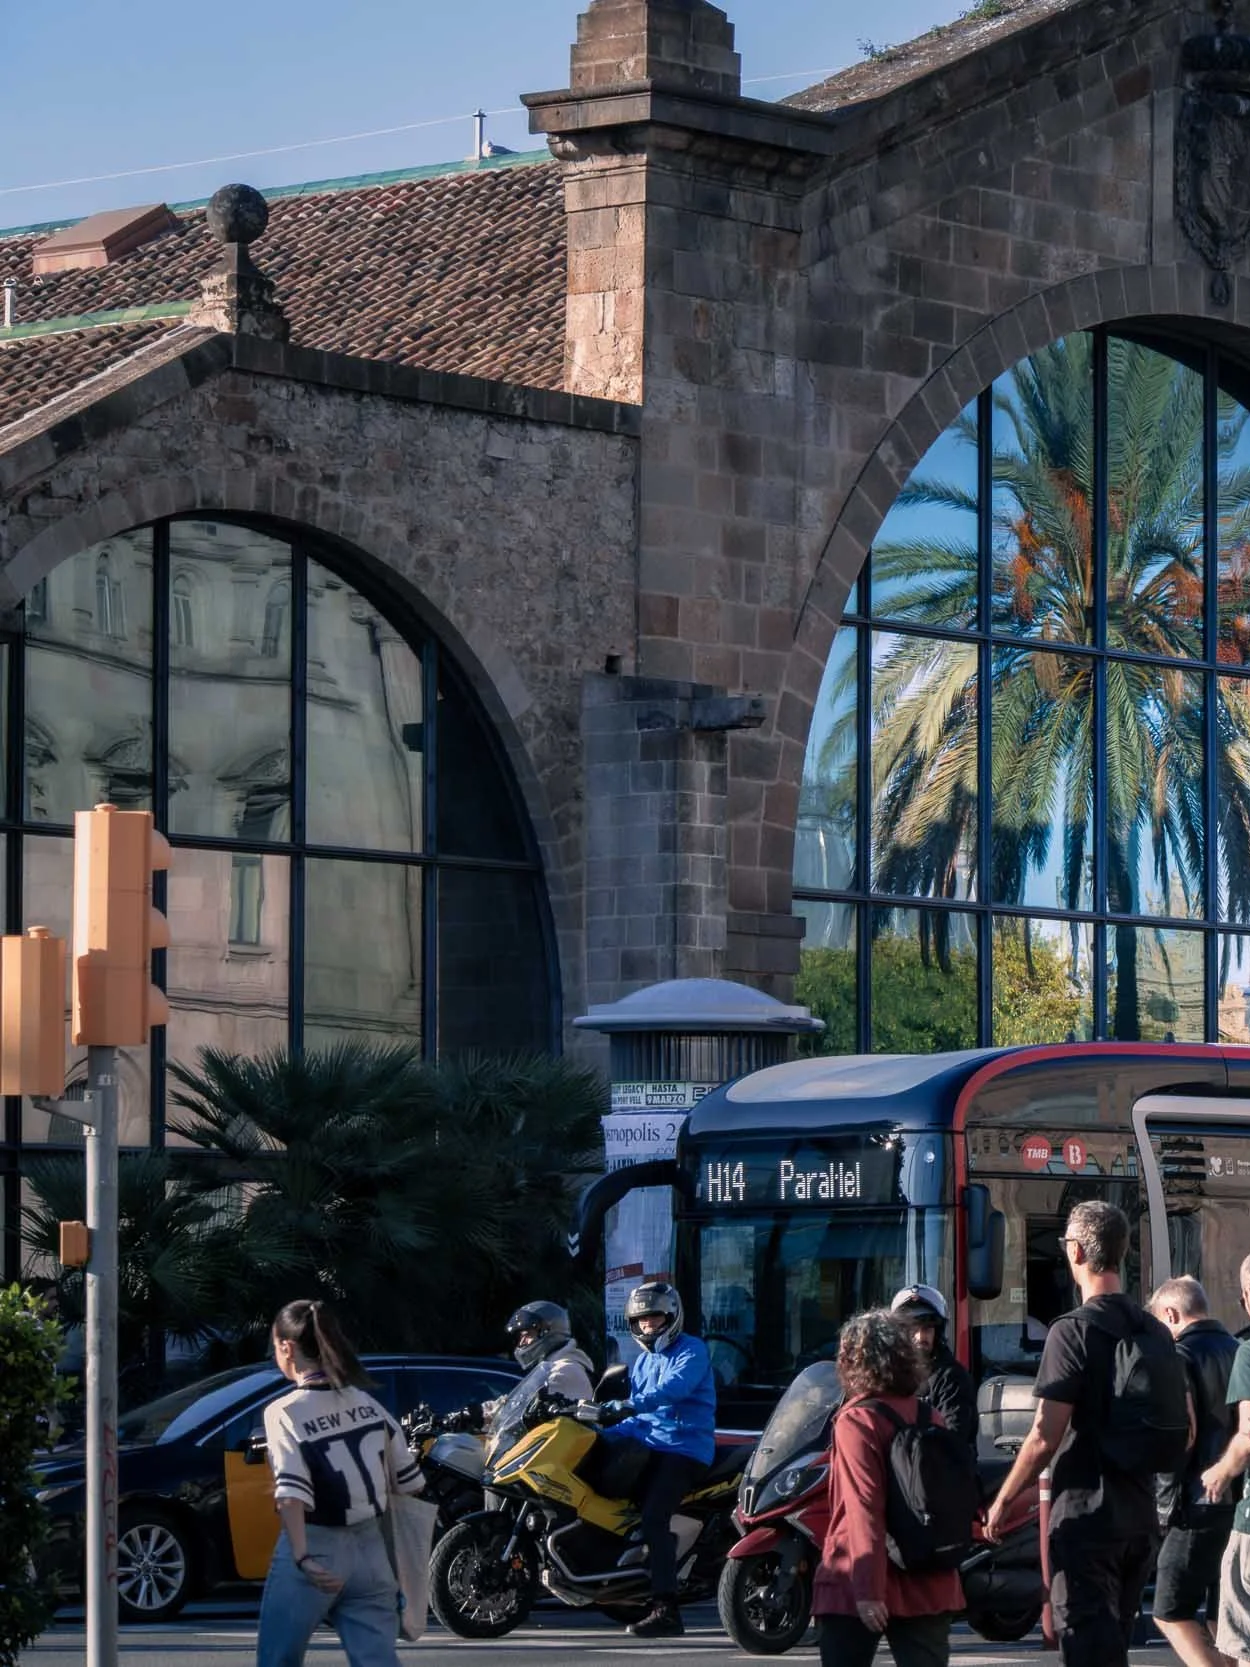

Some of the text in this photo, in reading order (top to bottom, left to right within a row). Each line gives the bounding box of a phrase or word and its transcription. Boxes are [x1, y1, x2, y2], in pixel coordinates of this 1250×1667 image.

[651, 1084, 678, 1093] HASTA
[1027, 1144, 1082, 1165] TMB B
[708, 1162, 746, 1202] H14
[302, 1412, 341, 1436] NEW
